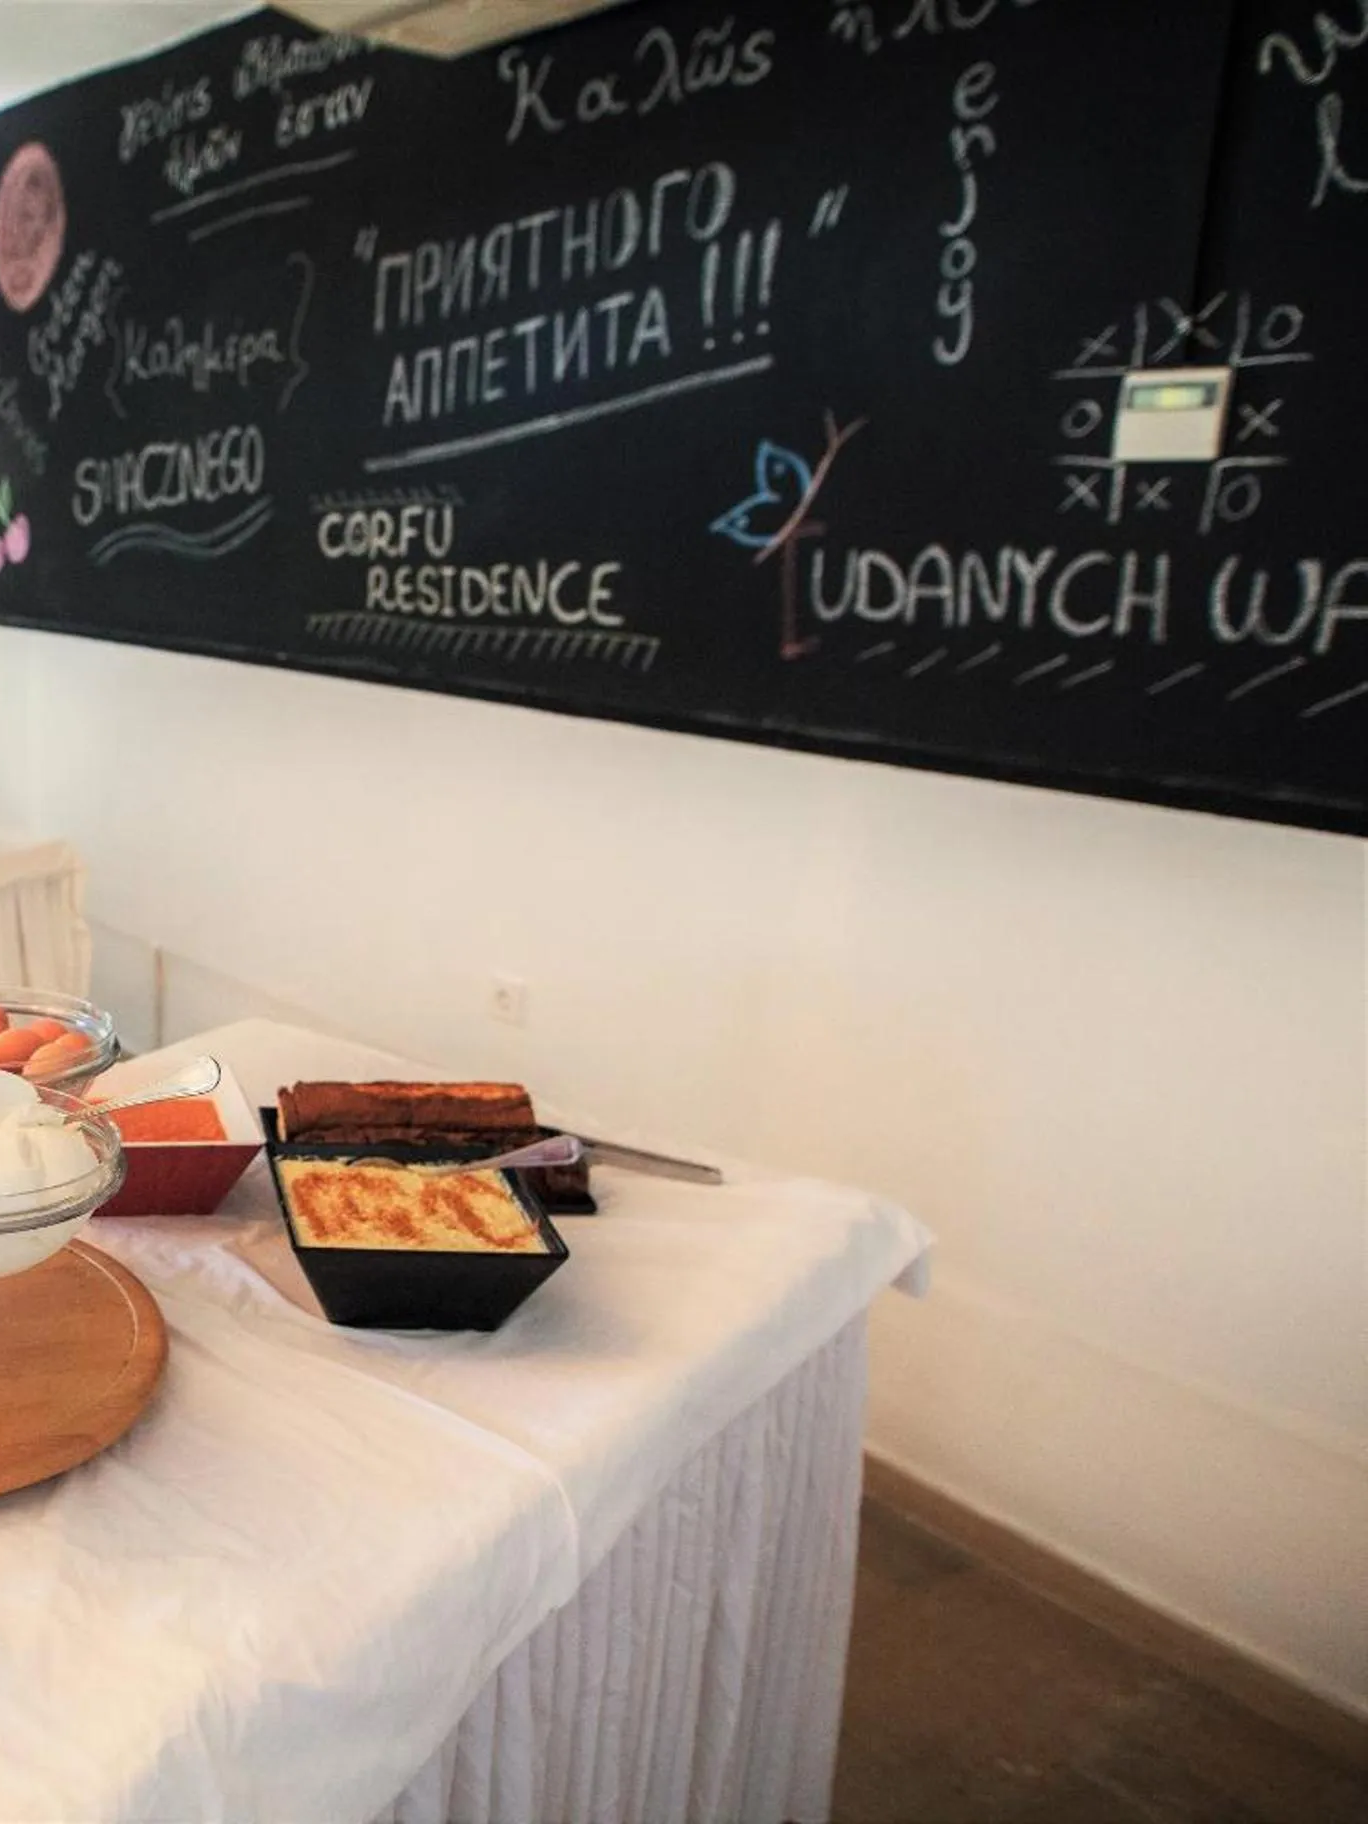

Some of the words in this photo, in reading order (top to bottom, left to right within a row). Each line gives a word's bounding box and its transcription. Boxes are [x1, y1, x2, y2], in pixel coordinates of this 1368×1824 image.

[934, 61, 999, 365] enjoy
[318, 504, 453, 559] CORFU
[366, 558, 625, 627] RESIDENCE
[810, 543, 1171, 645] UDANYCH
